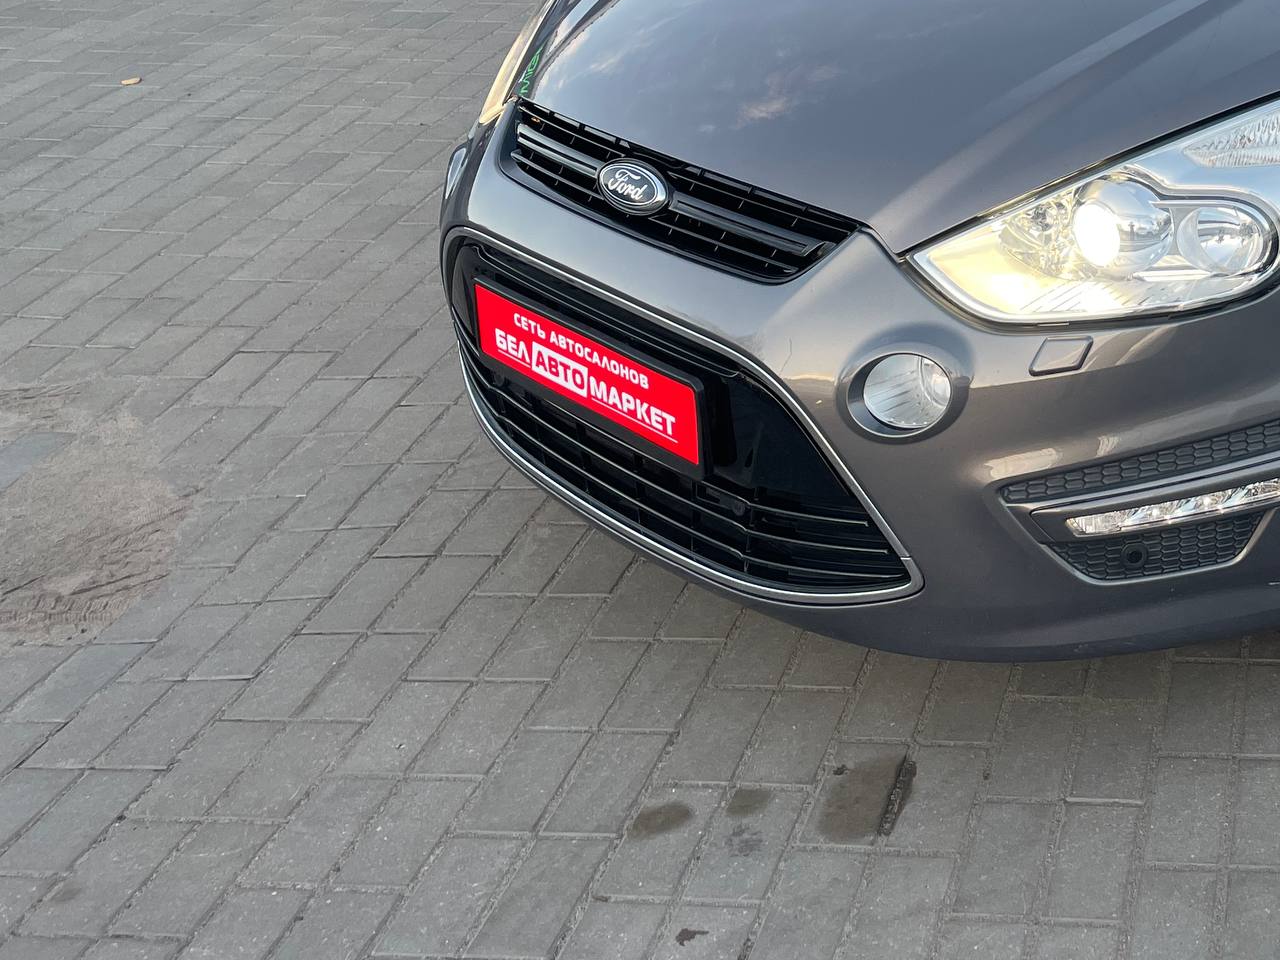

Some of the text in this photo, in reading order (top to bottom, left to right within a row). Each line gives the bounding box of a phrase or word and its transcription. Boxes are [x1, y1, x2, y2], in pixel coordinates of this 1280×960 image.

[607, 169, 648, 201] Ford
[494, 327, 677, 437] БЕЛ АВТО МАРКЕТ
[513, 312, 650, 390] СЕТЬ АВТОСАЛОНОВ
